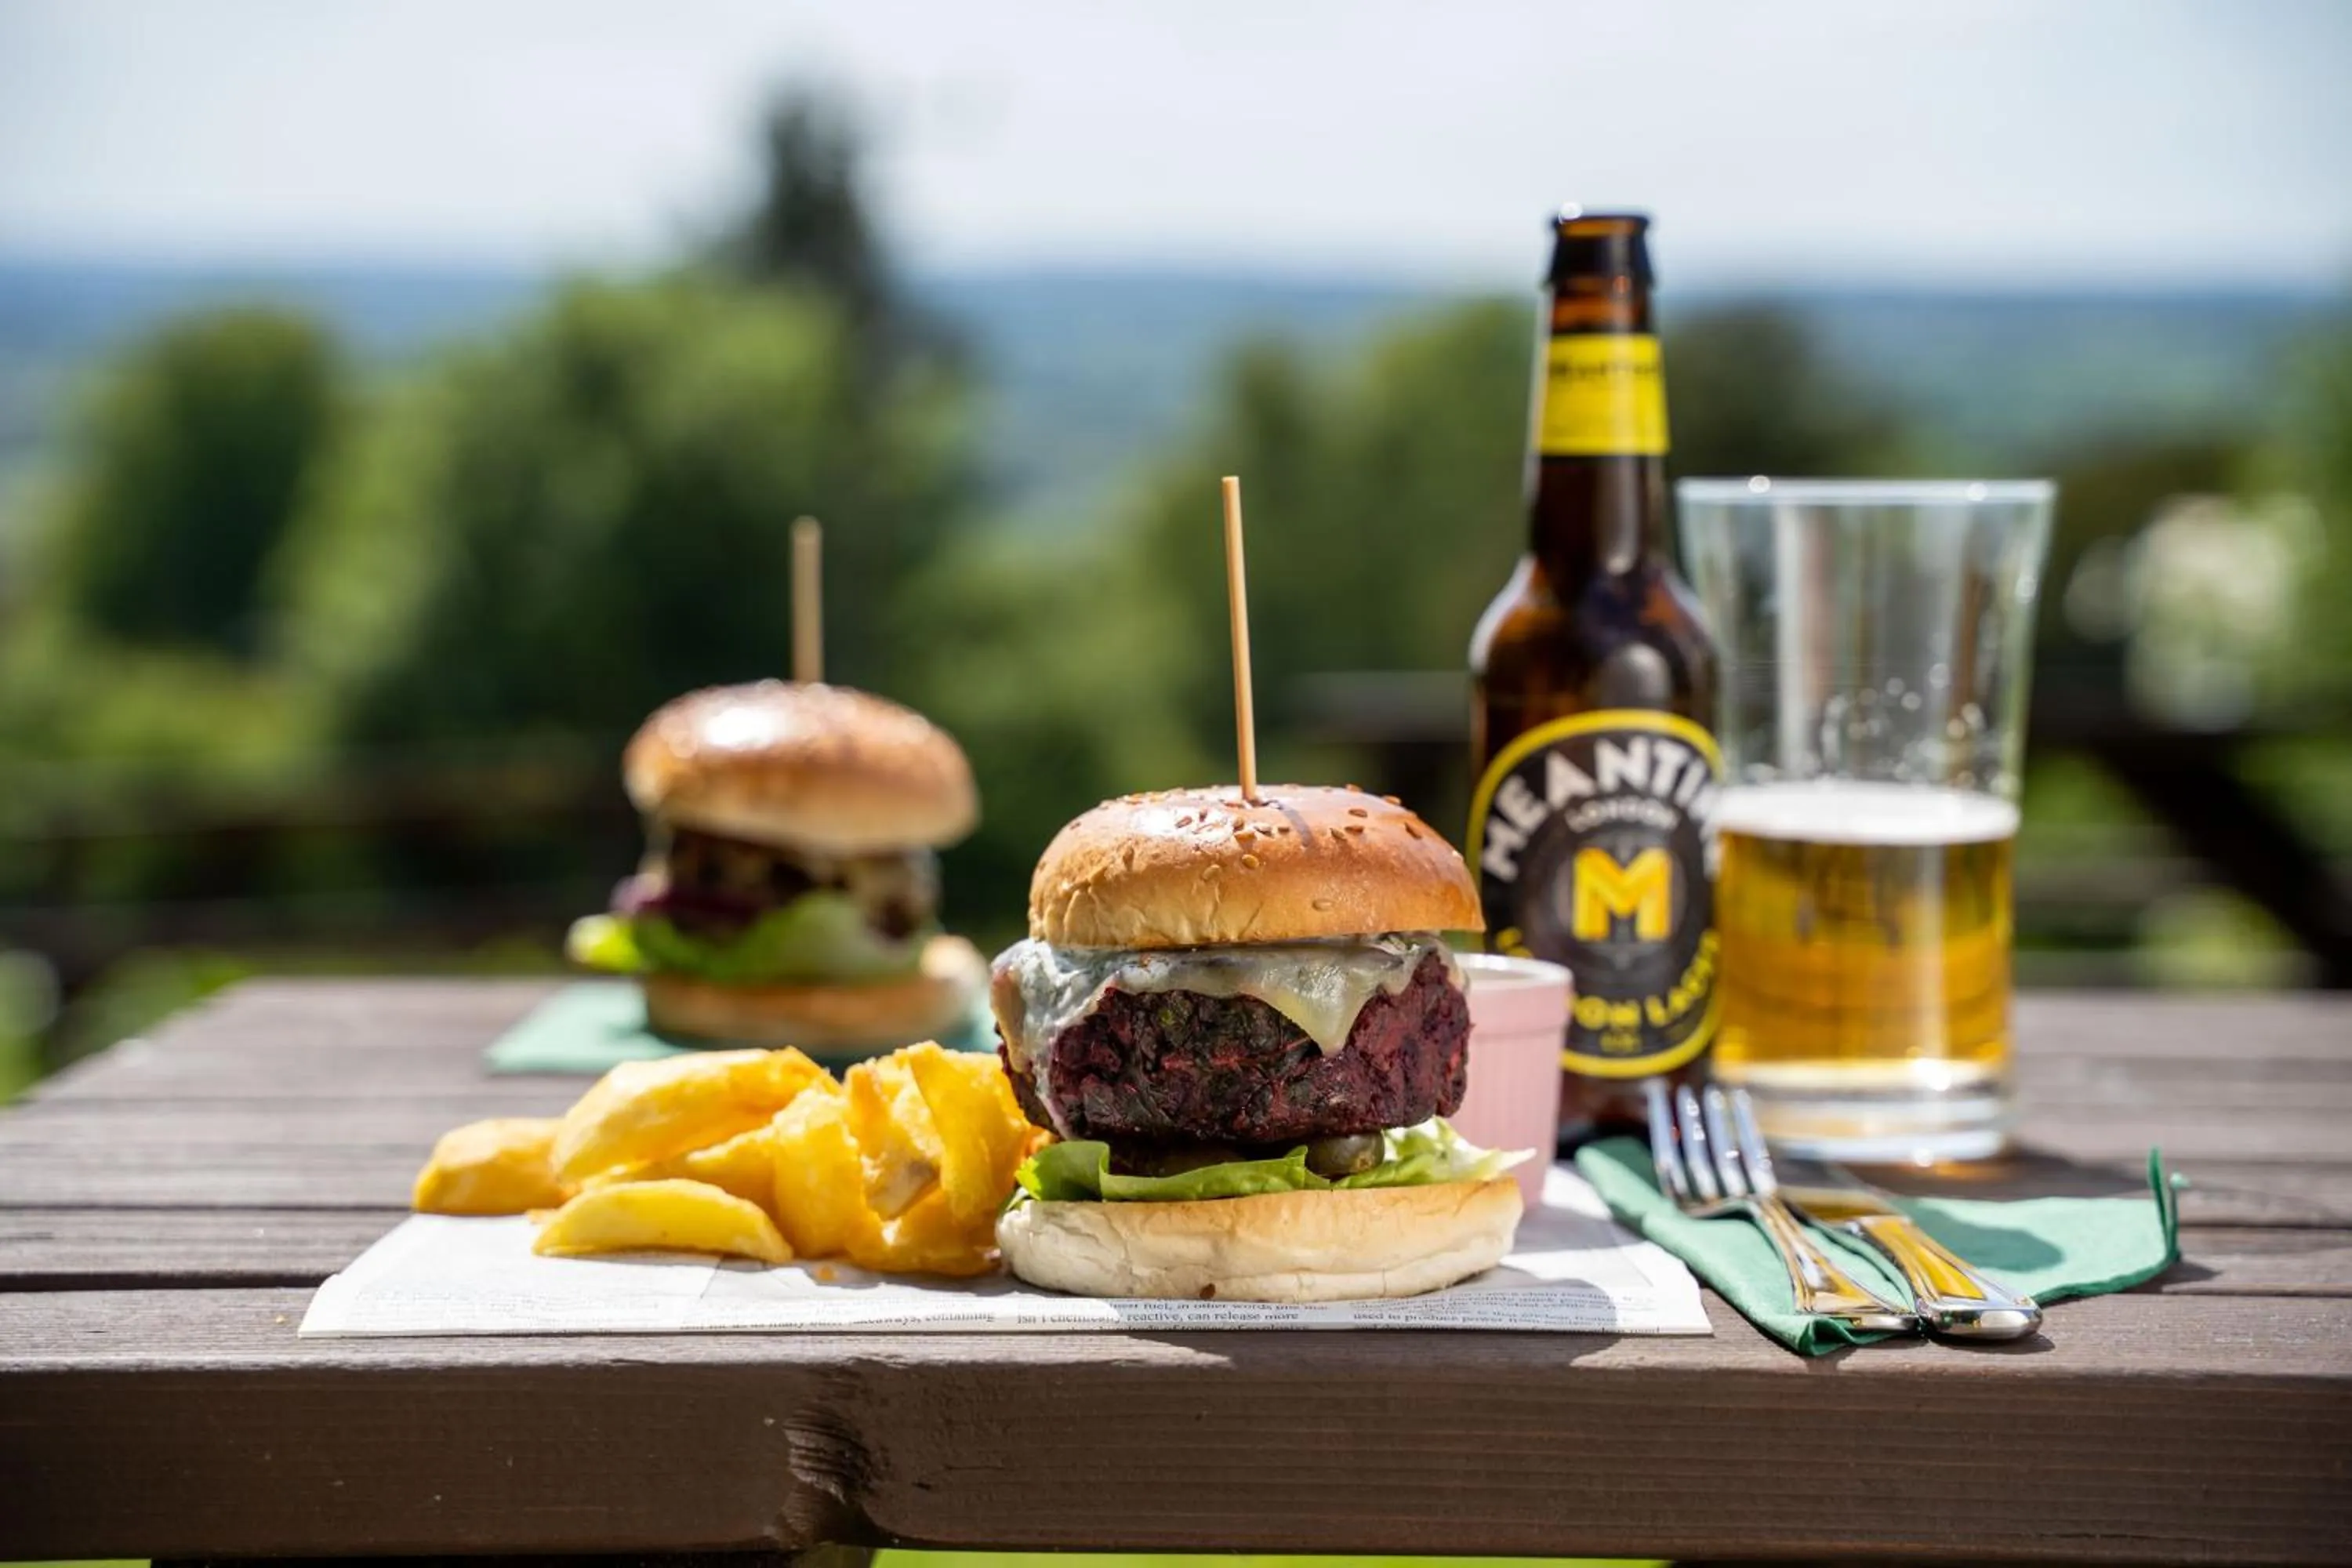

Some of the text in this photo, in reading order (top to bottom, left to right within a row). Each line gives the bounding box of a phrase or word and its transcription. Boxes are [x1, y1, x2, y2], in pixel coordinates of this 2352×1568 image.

[1572, 847, 1673, 941] M
[1127, 1312, 1184, 1322] reactive,
[1214, 1311, 1261, 1320] release
